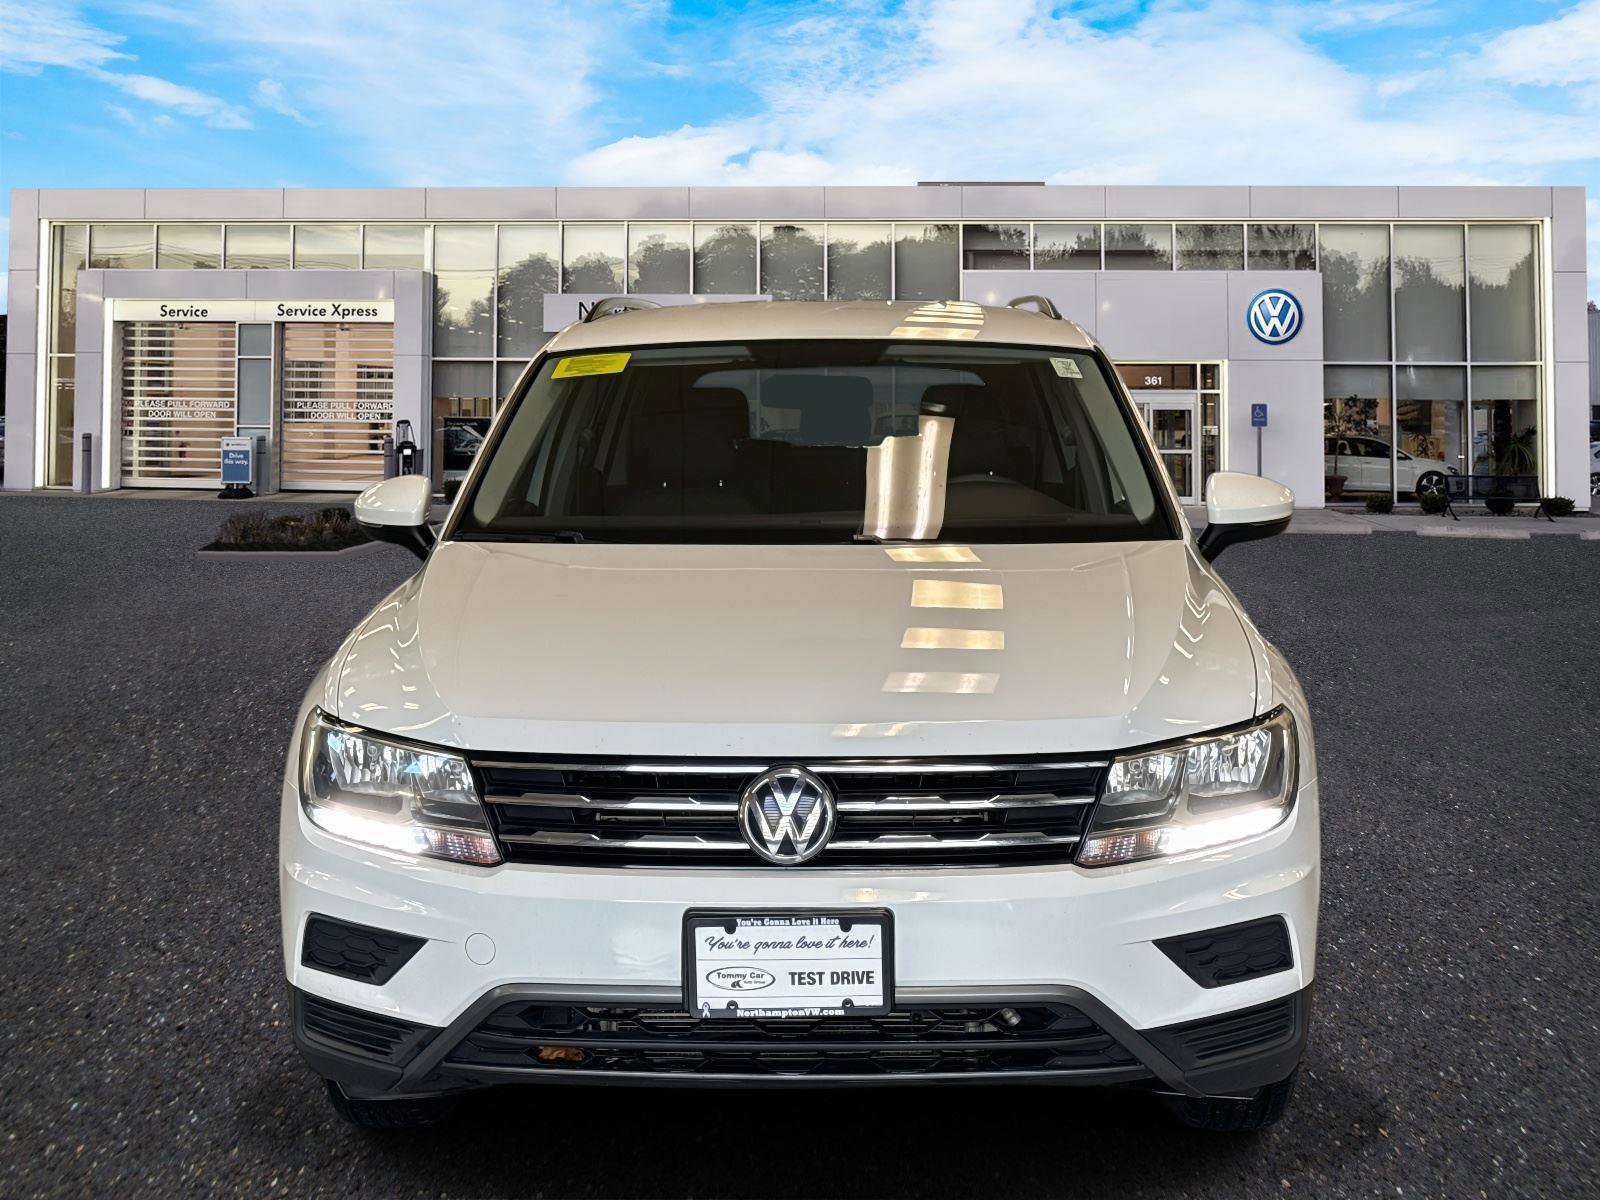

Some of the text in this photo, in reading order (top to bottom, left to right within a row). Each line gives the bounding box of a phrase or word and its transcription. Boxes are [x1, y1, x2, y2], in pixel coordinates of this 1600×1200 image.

[160, 304, 209, 318] Service
[277, 303, 378, 320] Service Xpress
[1144, 376, 1162, 386] 361
[135, 400, 230, 409] PLEASE PULL FORWARD
[296, 401, 394, 410] PLEASE PULL FORWARD
[148, 410, 217, 419] DOOR WILL OPEN
[310, 412, 381, 420] DOOR WILL OPEN
[736, 918, 762, 926] You're
[764, 918, 790, 926] Gonna
[791, 918, 811, 926] Love
[820, 917, 840, 925] Here
[705, 934, 875, 955] You're gonna love it here!
[716, 971, 765, 980] Tommy Car
[788, 970, 875, 985] TEST DRIVE
[736, 1008, 845, 1019] NorthamptonVW.com
